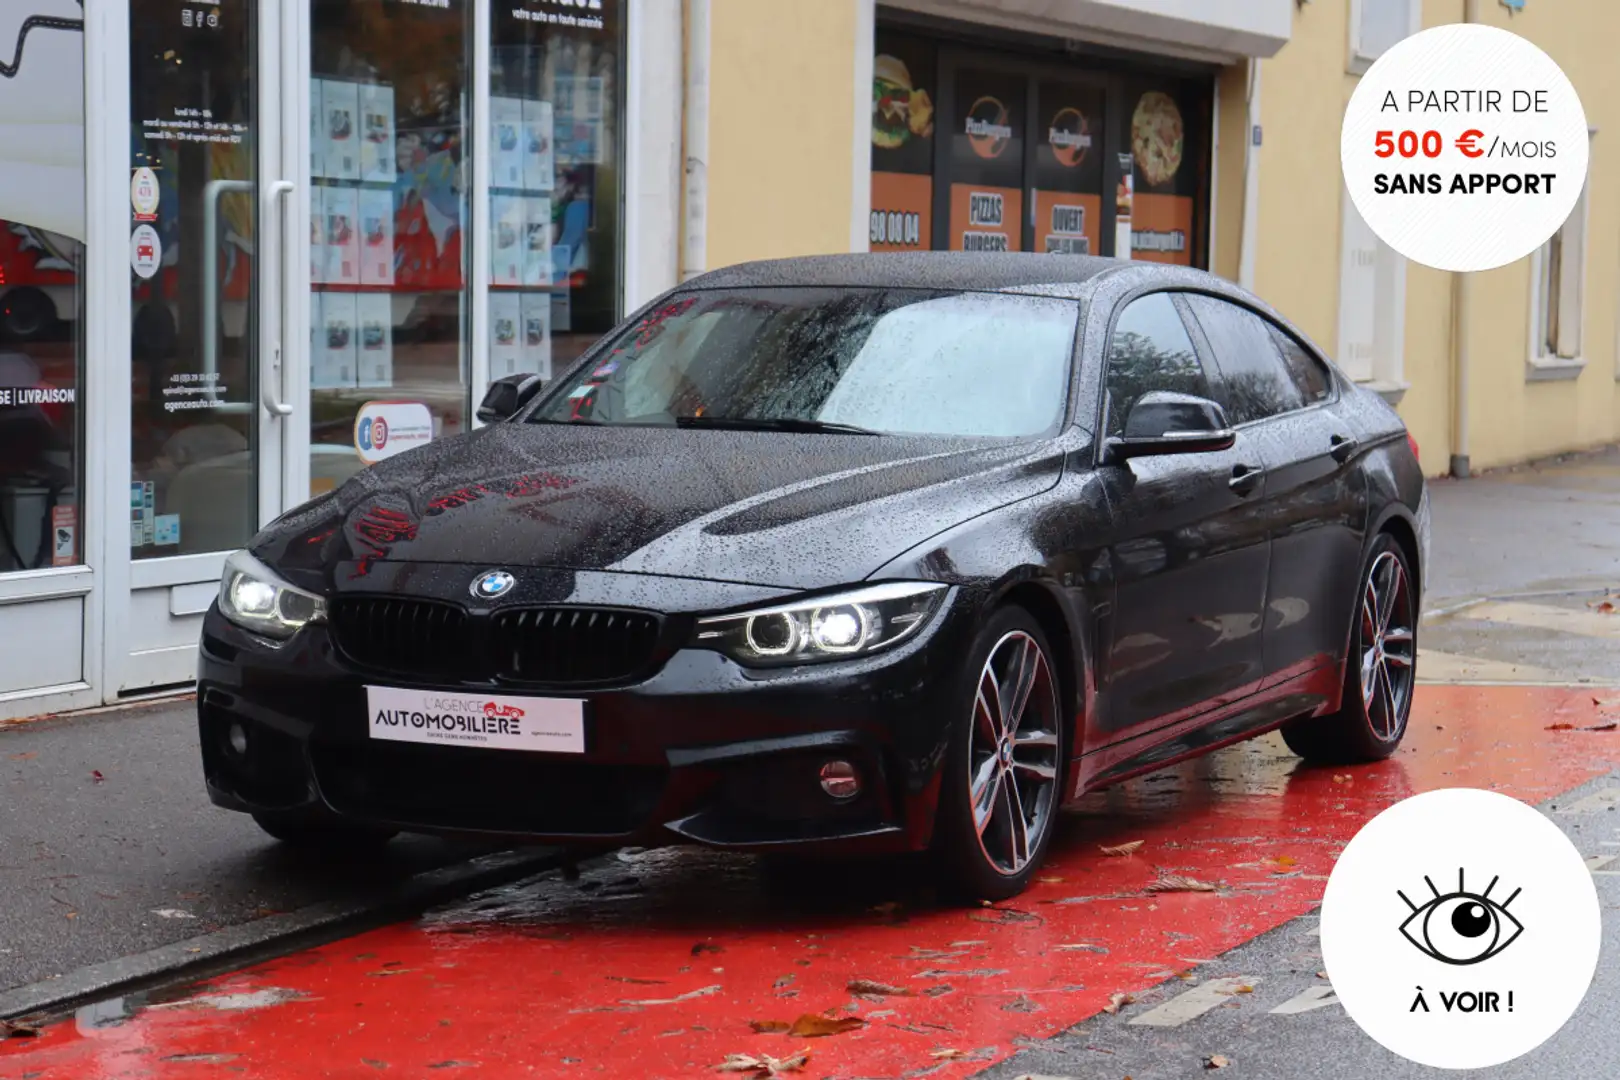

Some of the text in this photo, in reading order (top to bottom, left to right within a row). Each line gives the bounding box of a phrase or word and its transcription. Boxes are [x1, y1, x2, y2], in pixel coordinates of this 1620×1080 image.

[512, 8, 530, 20] votre
[531, 11, 548, 22] auto
[971, 194, 1002, 224] PIZZAS
[1053, 206, 1084, 232] OUVERT
[963, 233, 1007, 252] BURGERS
[0, 388, 75, 405] SE LIVRAISON
[424, 698, 484, 714] L'AGENCE
